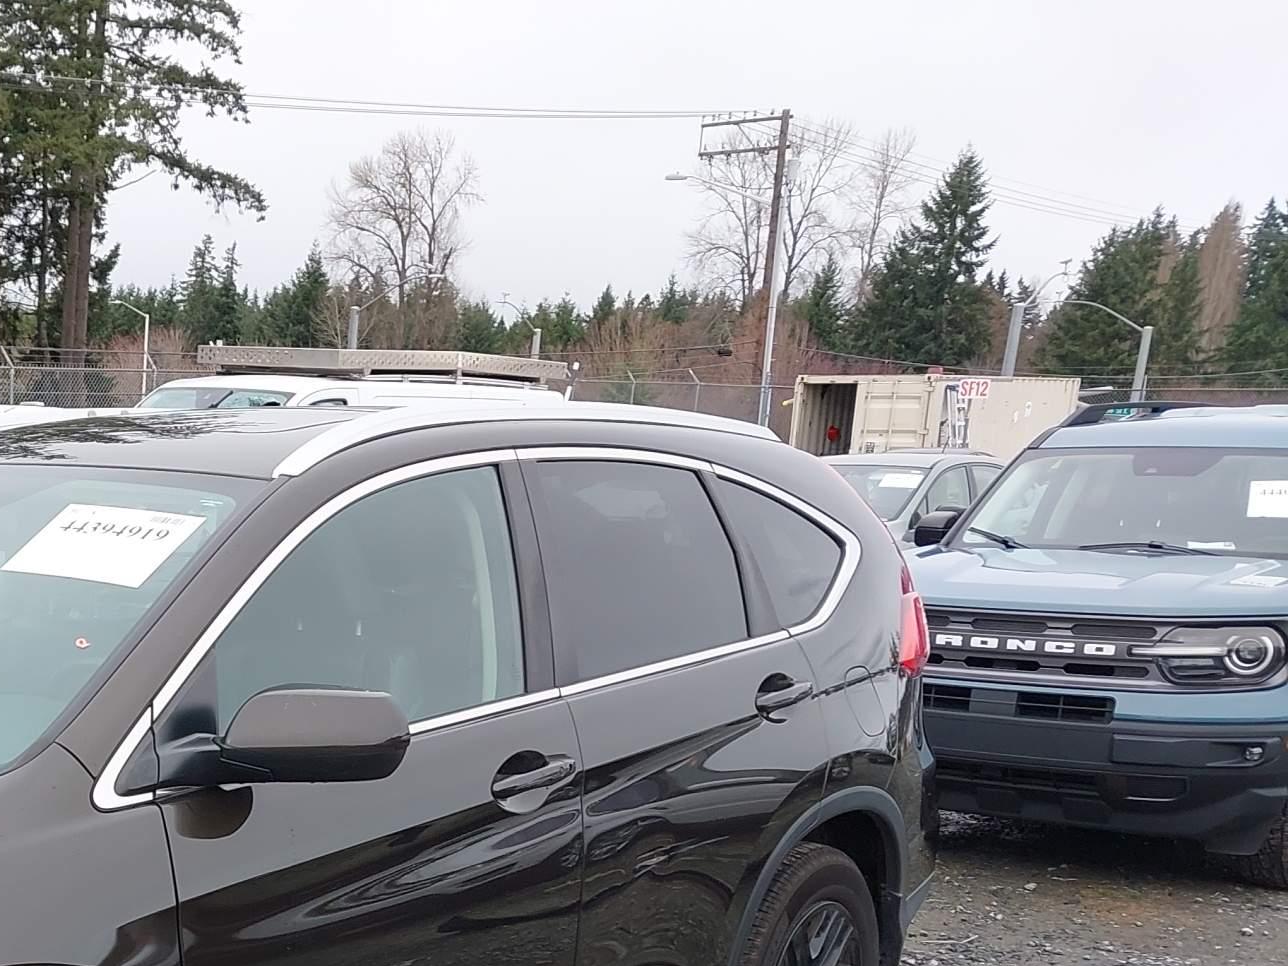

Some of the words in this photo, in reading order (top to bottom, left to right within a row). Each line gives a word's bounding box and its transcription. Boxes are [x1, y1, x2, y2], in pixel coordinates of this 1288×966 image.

[959, 381, 989, 397] SF12
[59, 520, 170, 540] 44394919
[935, 634, 1116, 656] RONCO
